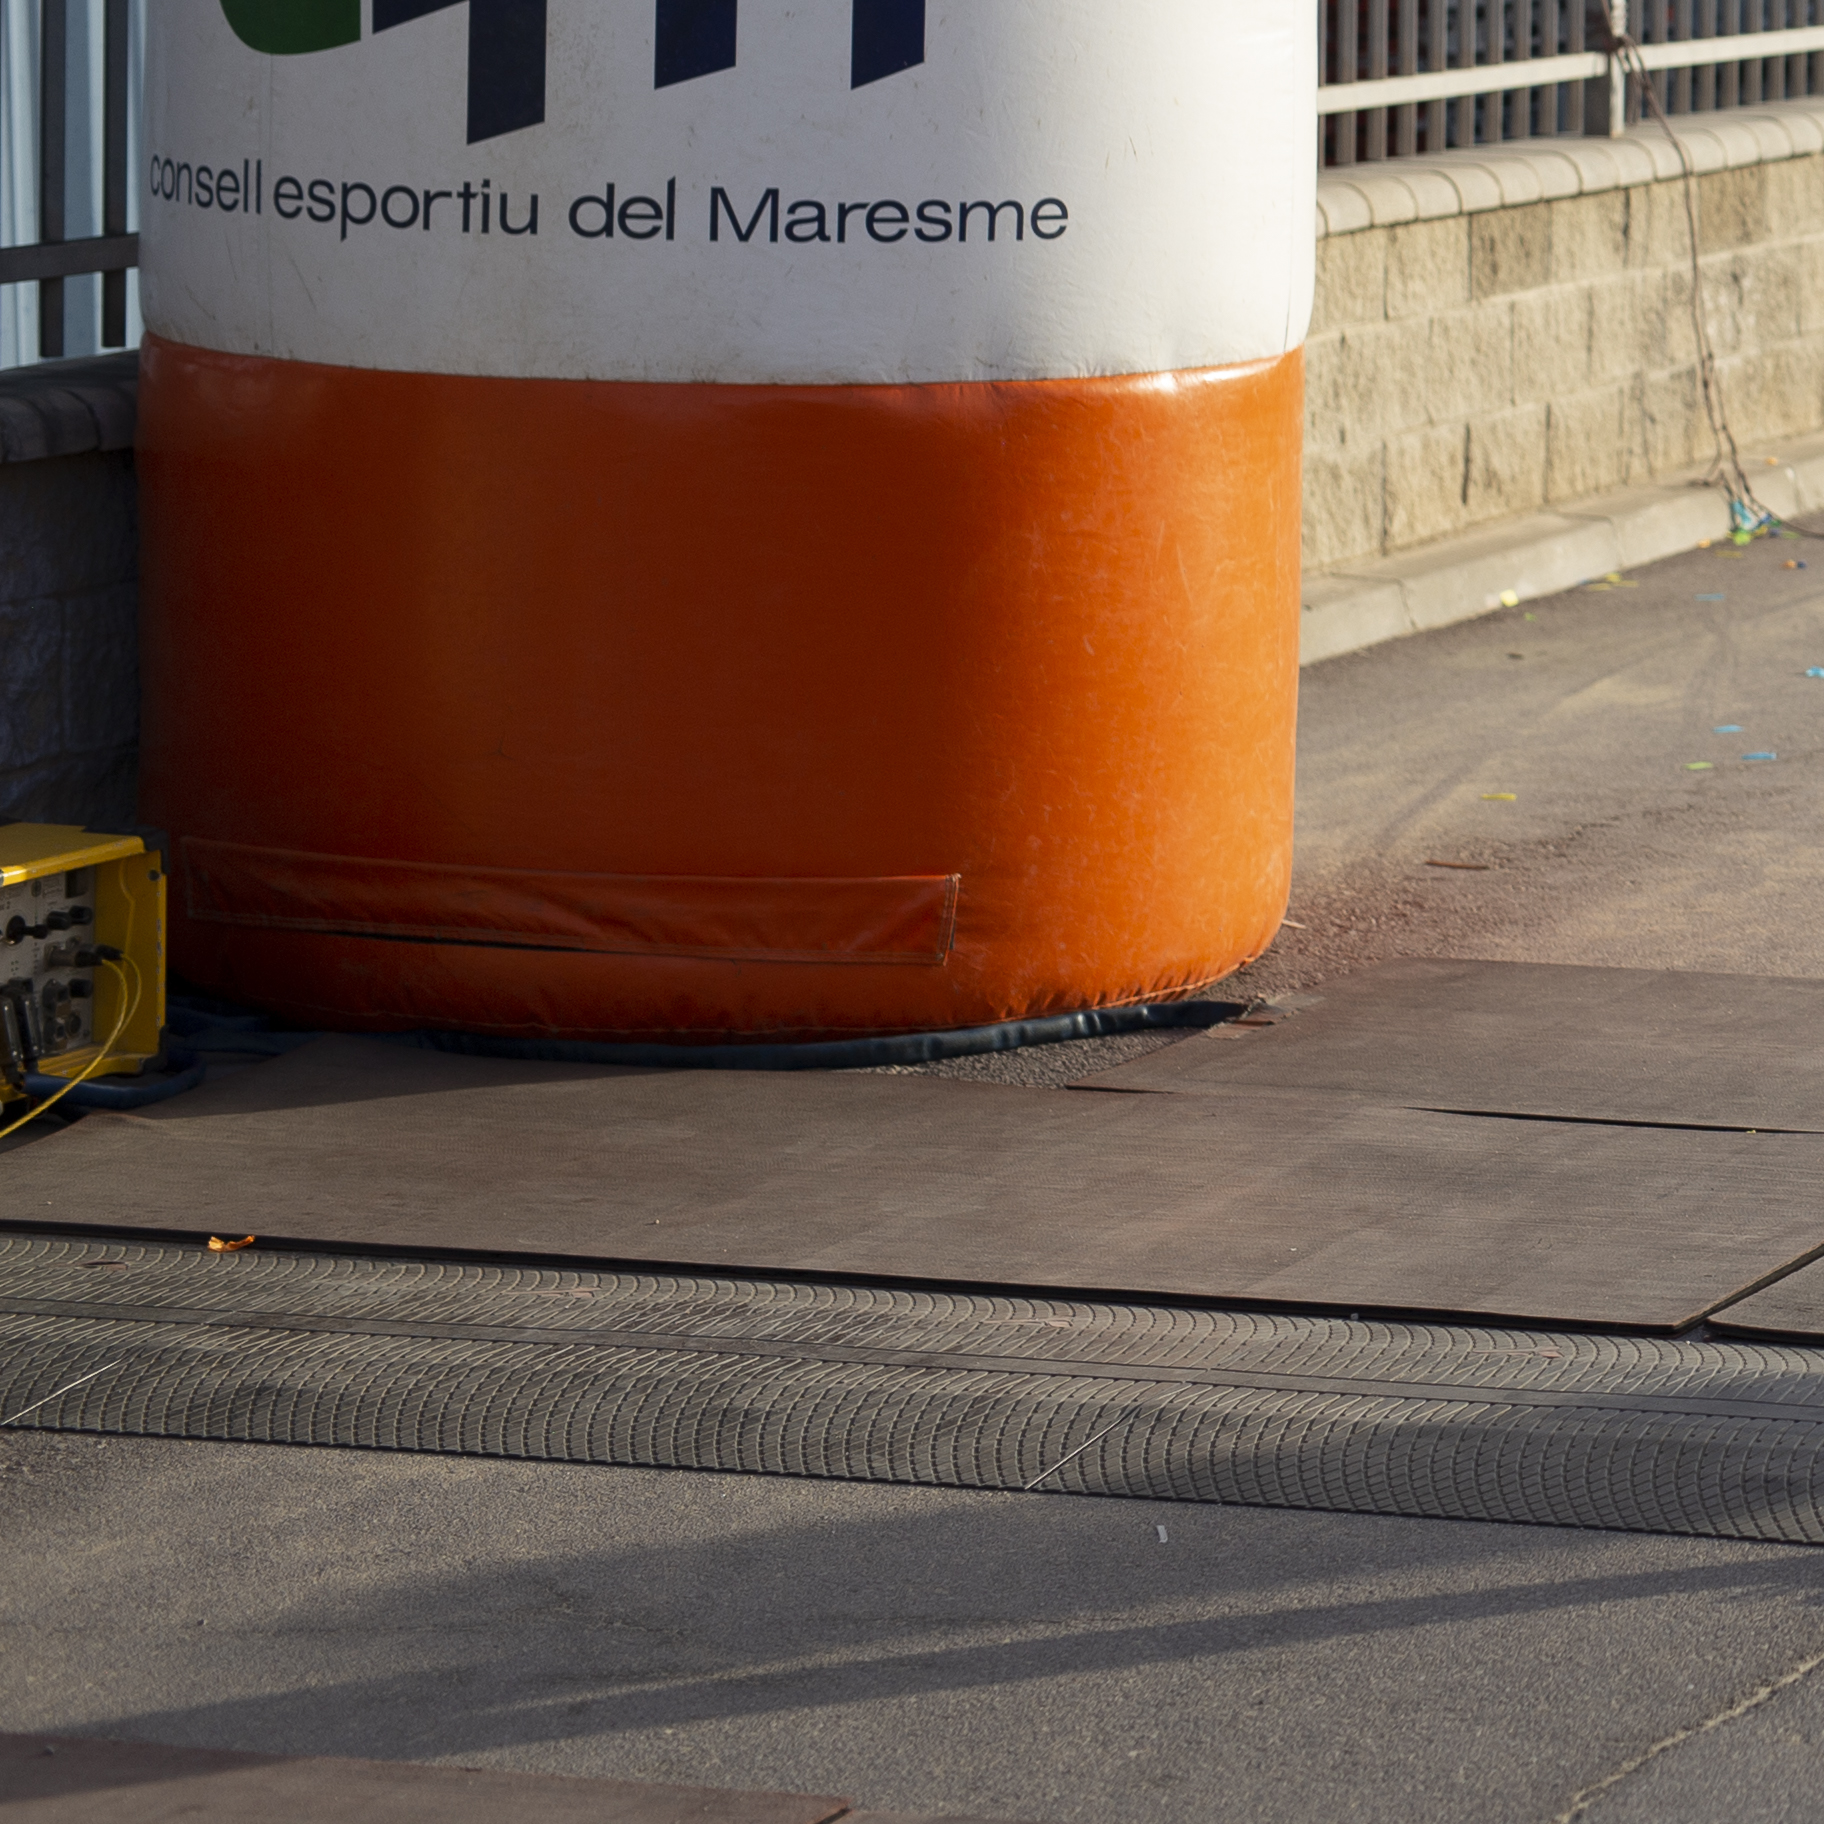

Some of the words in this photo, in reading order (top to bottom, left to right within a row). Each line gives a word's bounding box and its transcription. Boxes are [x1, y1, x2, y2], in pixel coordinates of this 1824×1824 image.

[149, 154, 262, 215] consell
[272, 176, 541, 243] esportiu
[568, 176, 677, 241] del
[708, 186, 1069, 244] Maresme
